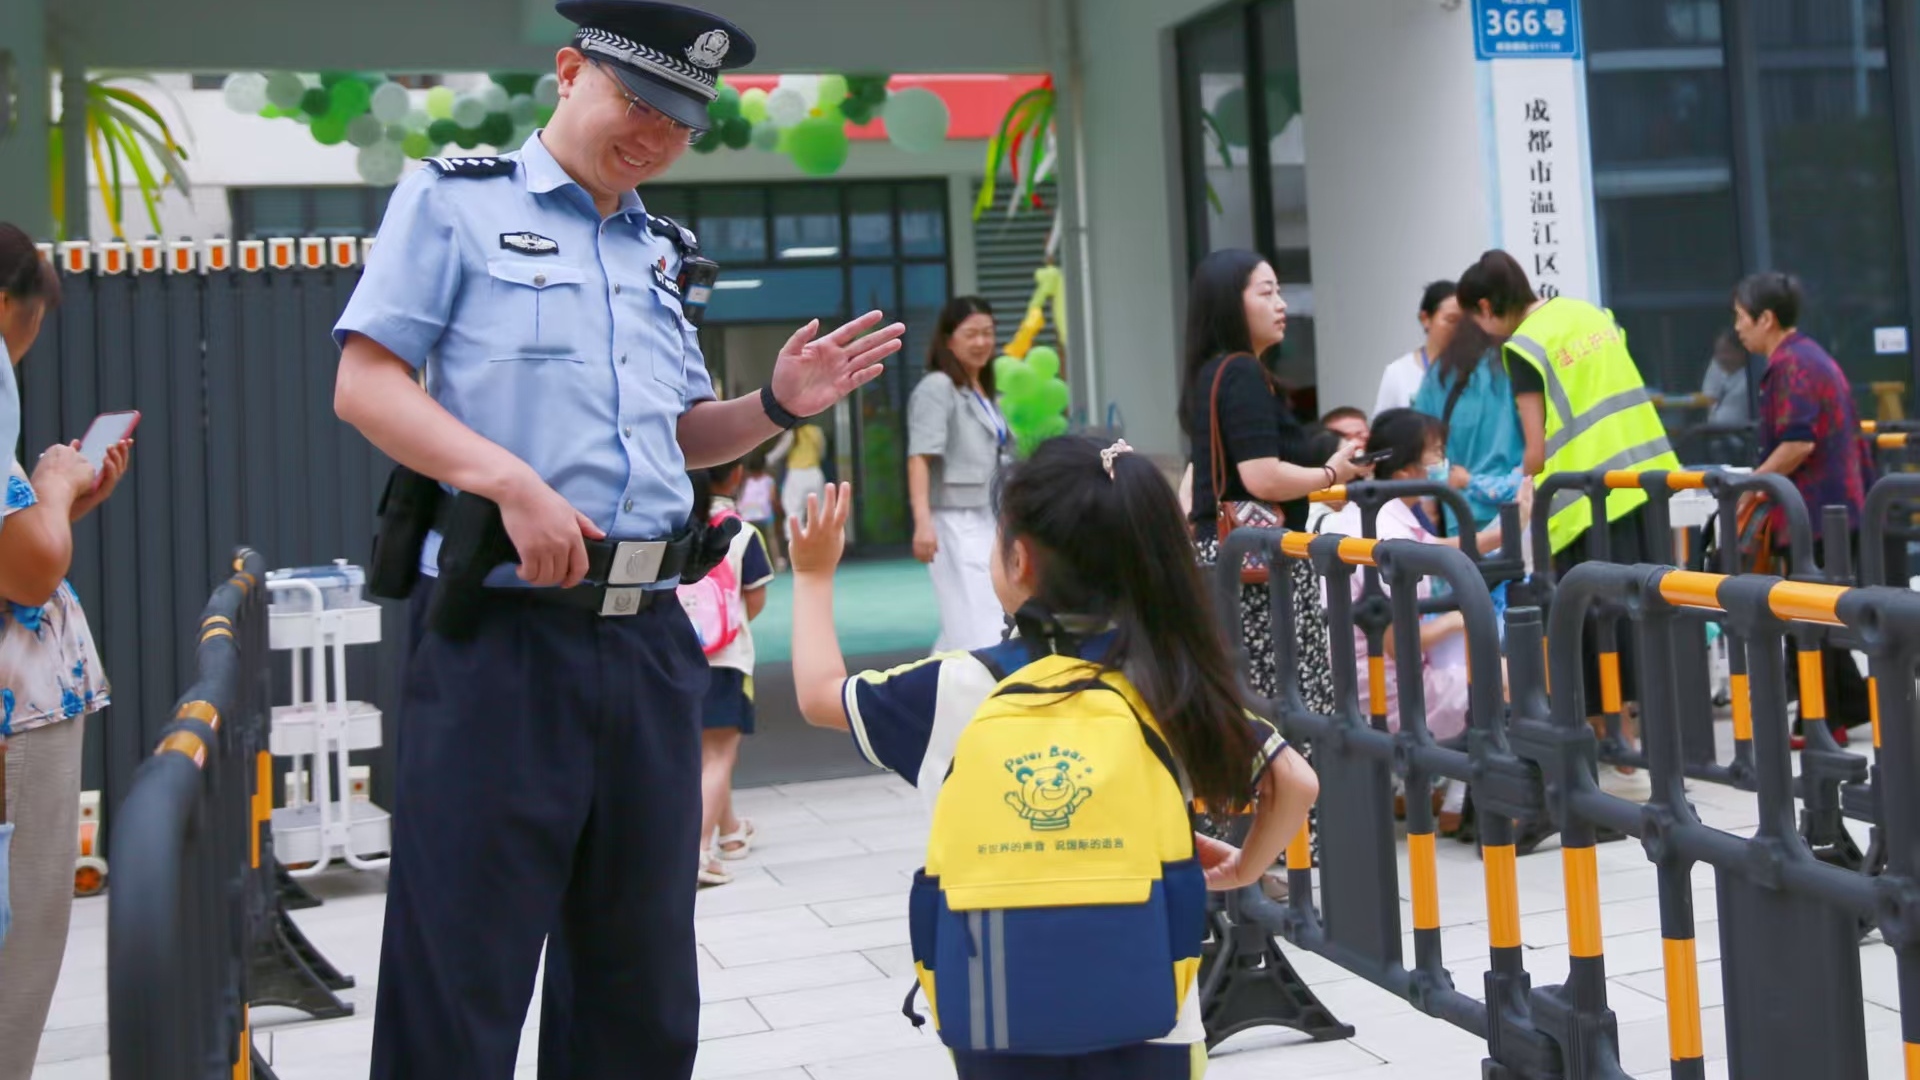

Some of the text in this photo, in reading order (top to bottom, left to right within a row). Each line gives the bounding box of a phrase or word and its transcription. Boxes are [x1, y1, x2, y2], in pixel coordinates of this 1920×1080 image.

[1486, 9, 1566, 36] 366号
[1004, 745, 1086, 774] Peter Bear
